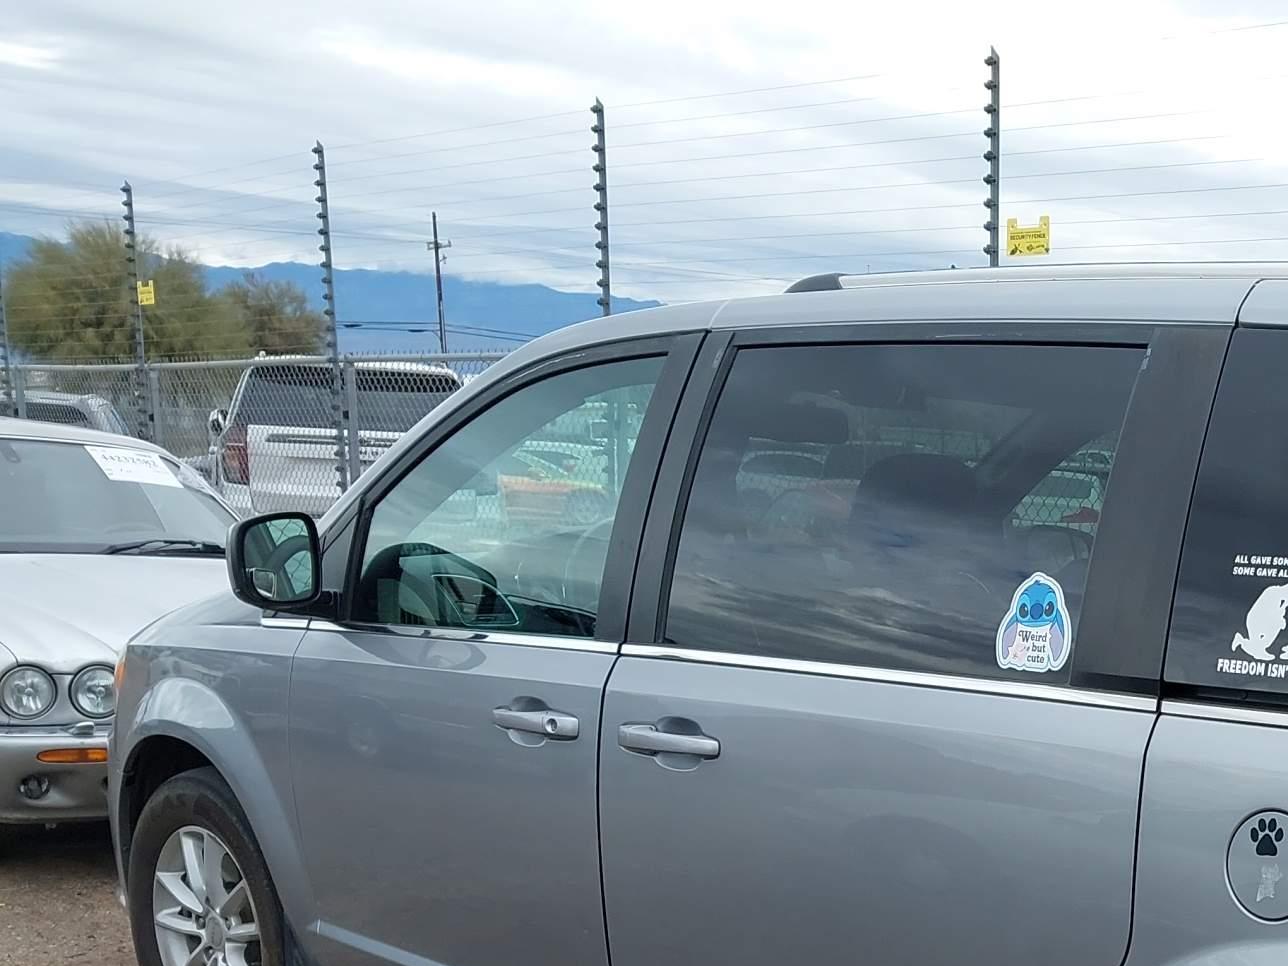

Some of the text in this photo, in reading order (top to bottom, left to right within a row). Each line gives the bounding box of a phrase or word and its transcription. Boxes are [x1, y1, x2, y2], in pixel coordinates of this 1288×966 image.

[1234, 555, 1249, 564] ALL
[1251, 556, 1272, 565] GAVE
[1232, 566, 1255, 576] SOME
[1256, 567, 1278, 577] GAVE
[1018, 630, 1048, 643] Weird
[1031, 642, 1046, 653] but
[1026, 654, 1045, 664] cute
[1217, 658, 1266, 676] FREEDOM
